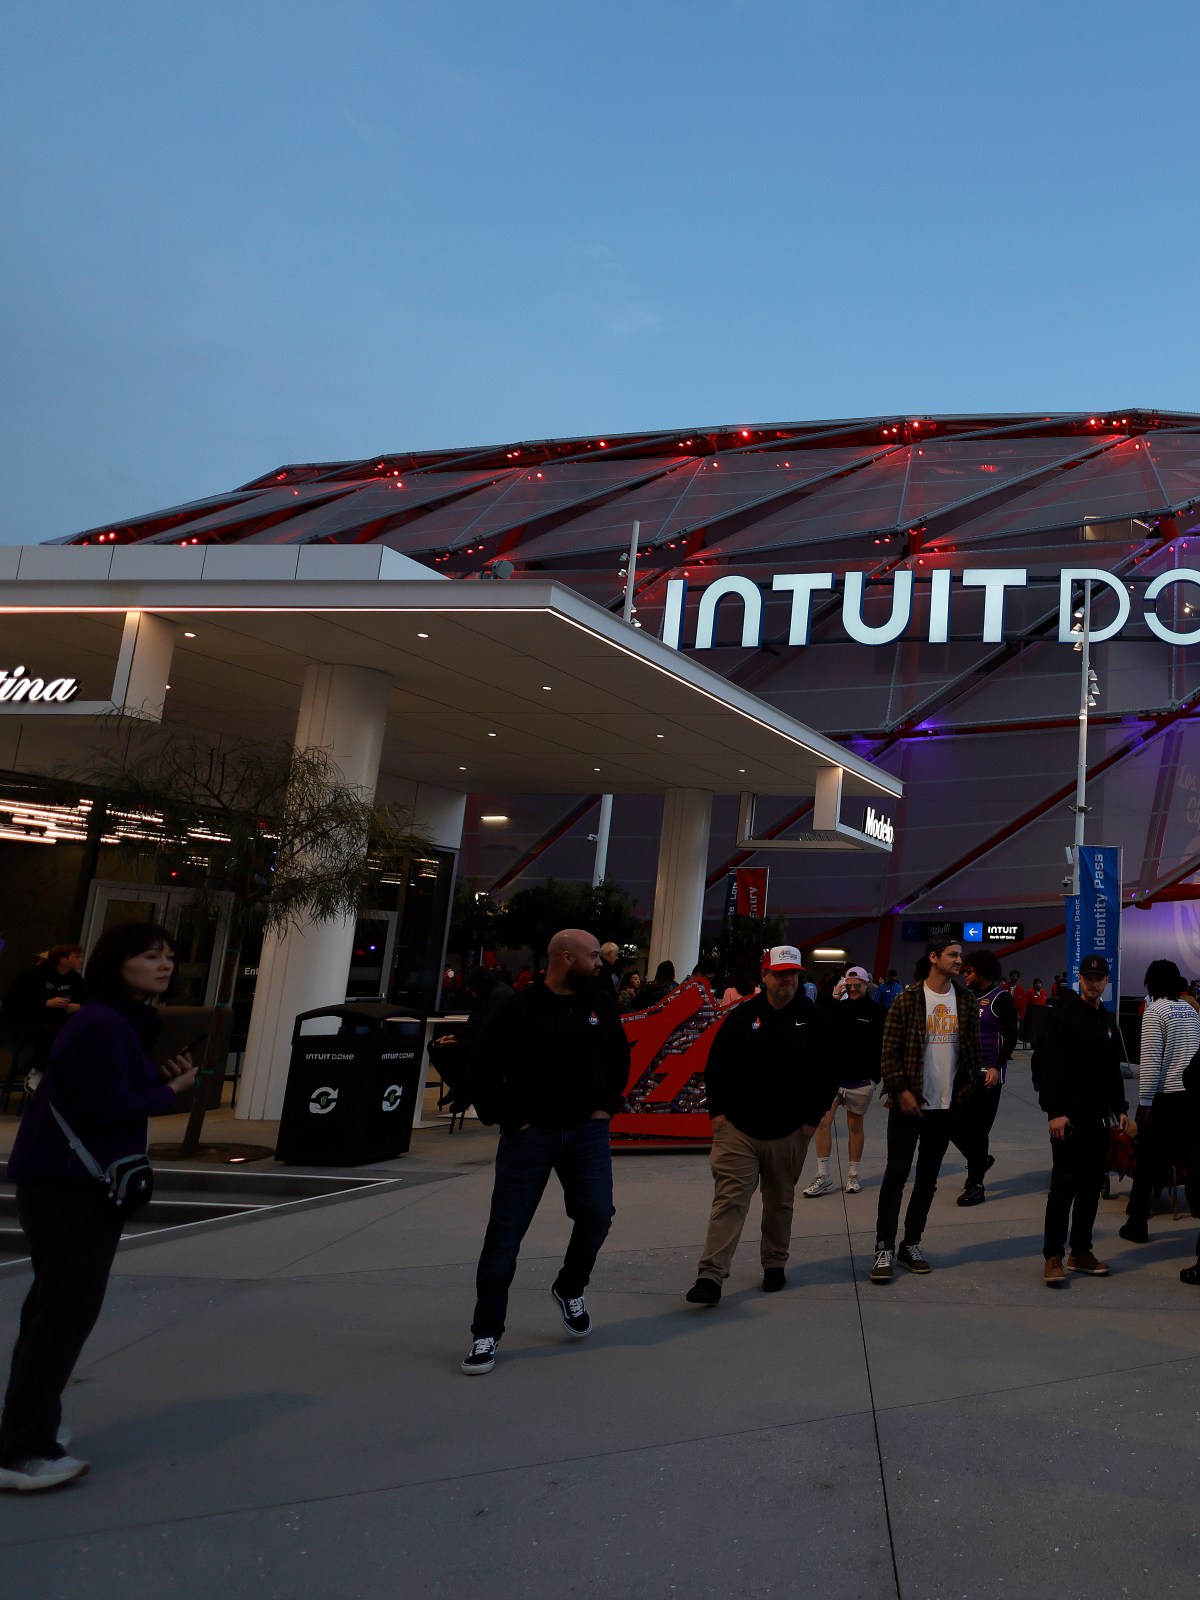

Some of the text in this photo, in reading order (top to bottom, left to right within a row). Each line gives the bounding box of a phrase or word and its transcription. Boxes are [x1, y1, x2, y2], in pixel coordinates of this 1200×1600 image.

[865, 806, 894, 843] Modelo
[1094, 853, 1107, 950] Identity Pass
[987, 926, 1018, 934] INTUIT
